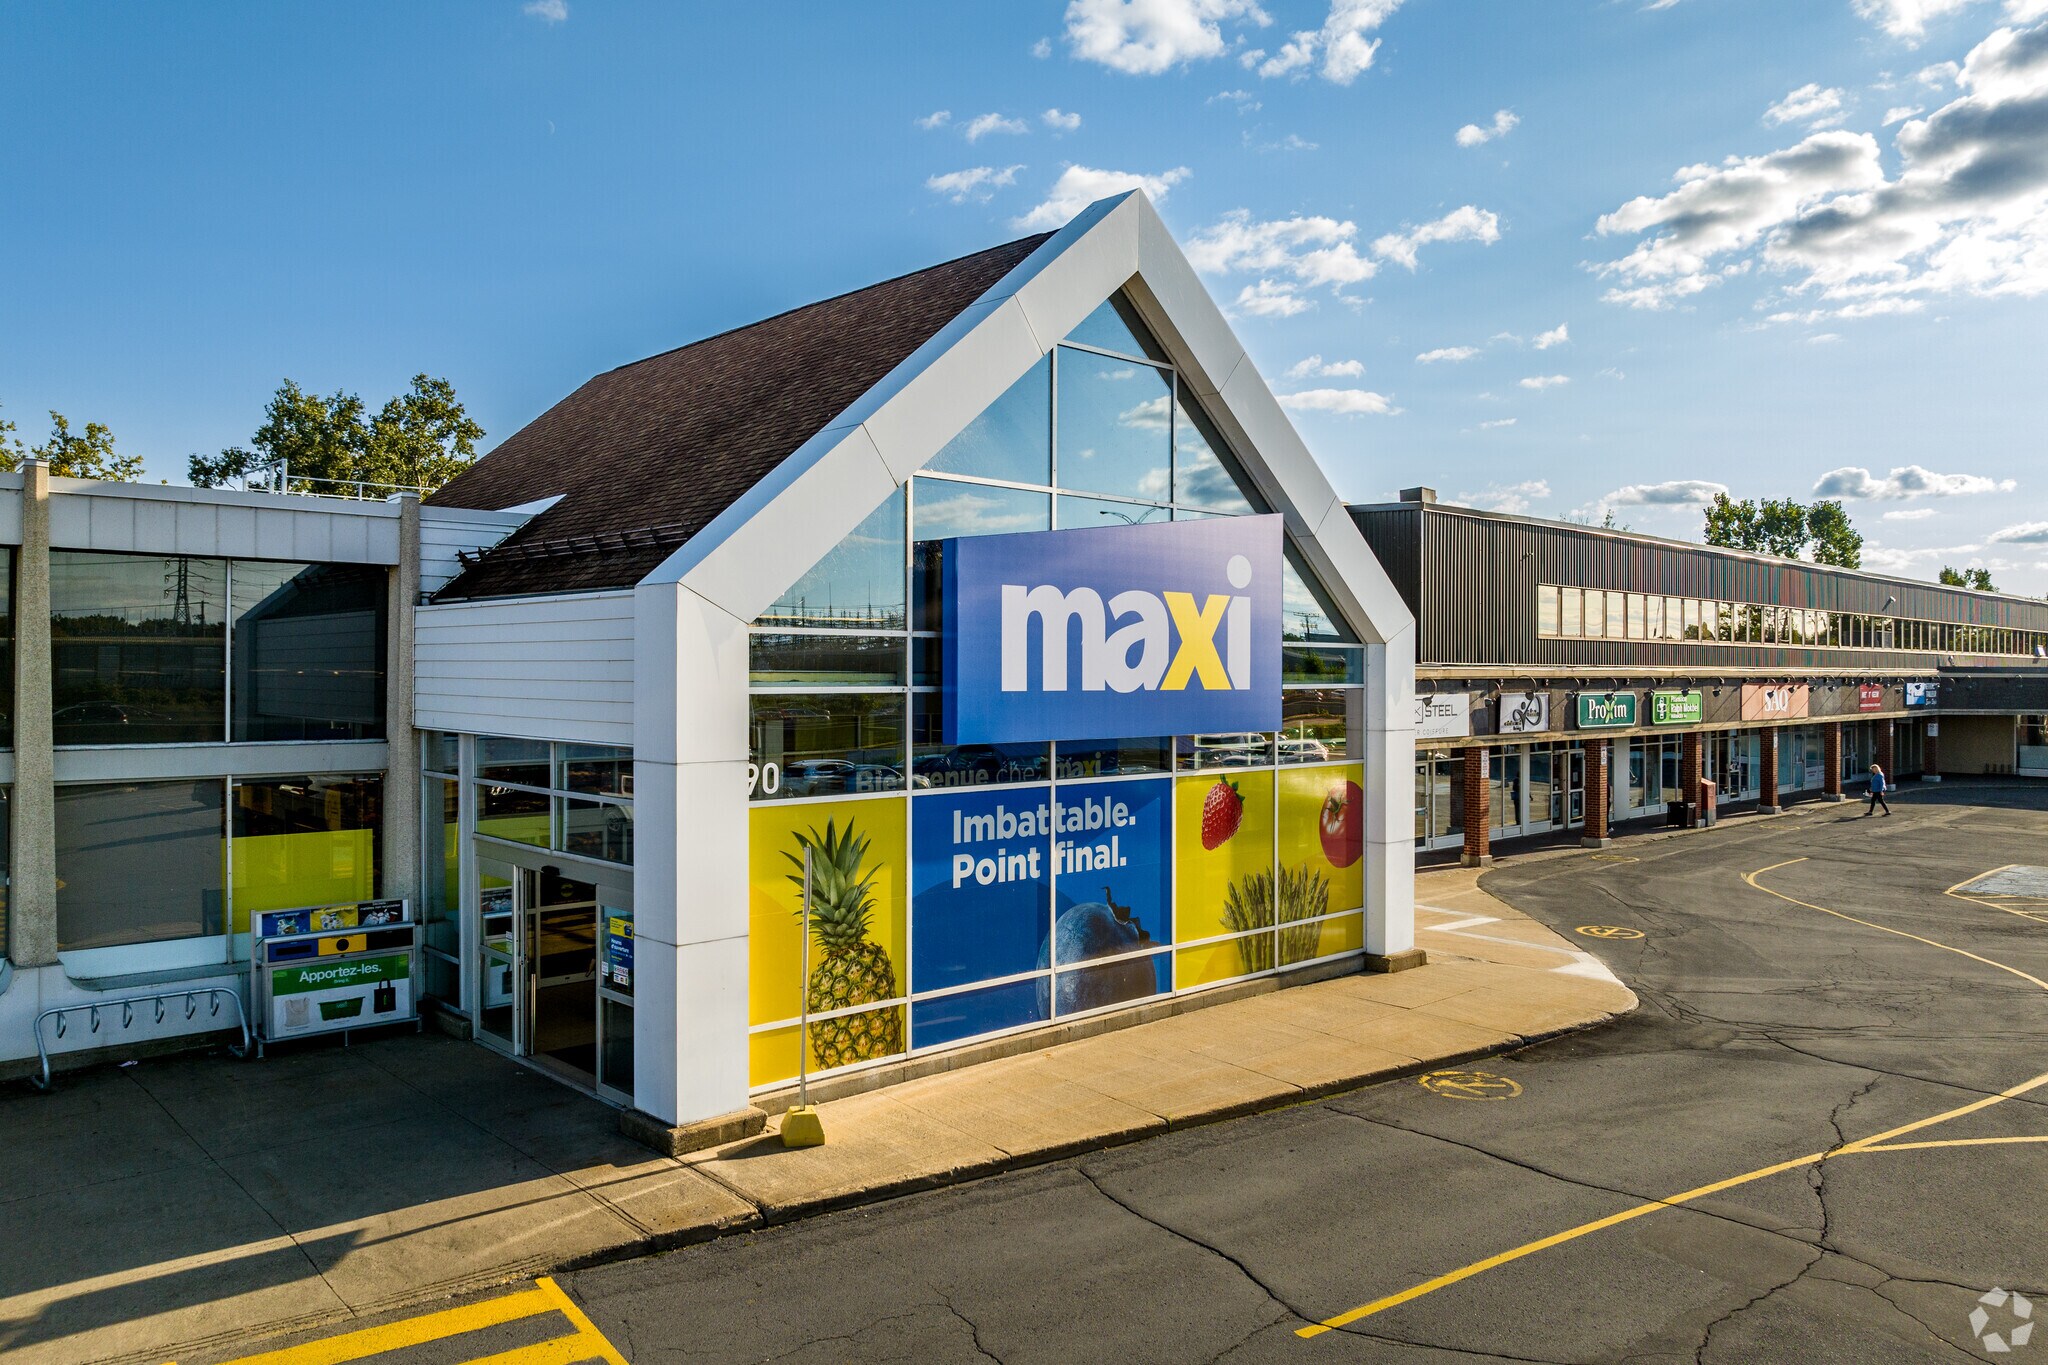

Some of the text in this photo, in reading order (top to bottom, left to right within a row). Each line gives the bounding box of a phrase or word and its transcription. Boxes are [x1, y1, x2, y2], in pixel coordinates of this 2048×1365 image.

[1001, 554, 1252, 693] maxi
[1424, 704, 1458, 718] STEEL
[1765, 690, 1789, 712] SAQ
[856, 768, 989, 793] Bievenue
[953, 796, 1136, 844] Imbattable.
[953, 835, 1127, 889] Point final.
[299, 963, 383, 984] Apportez-les.
